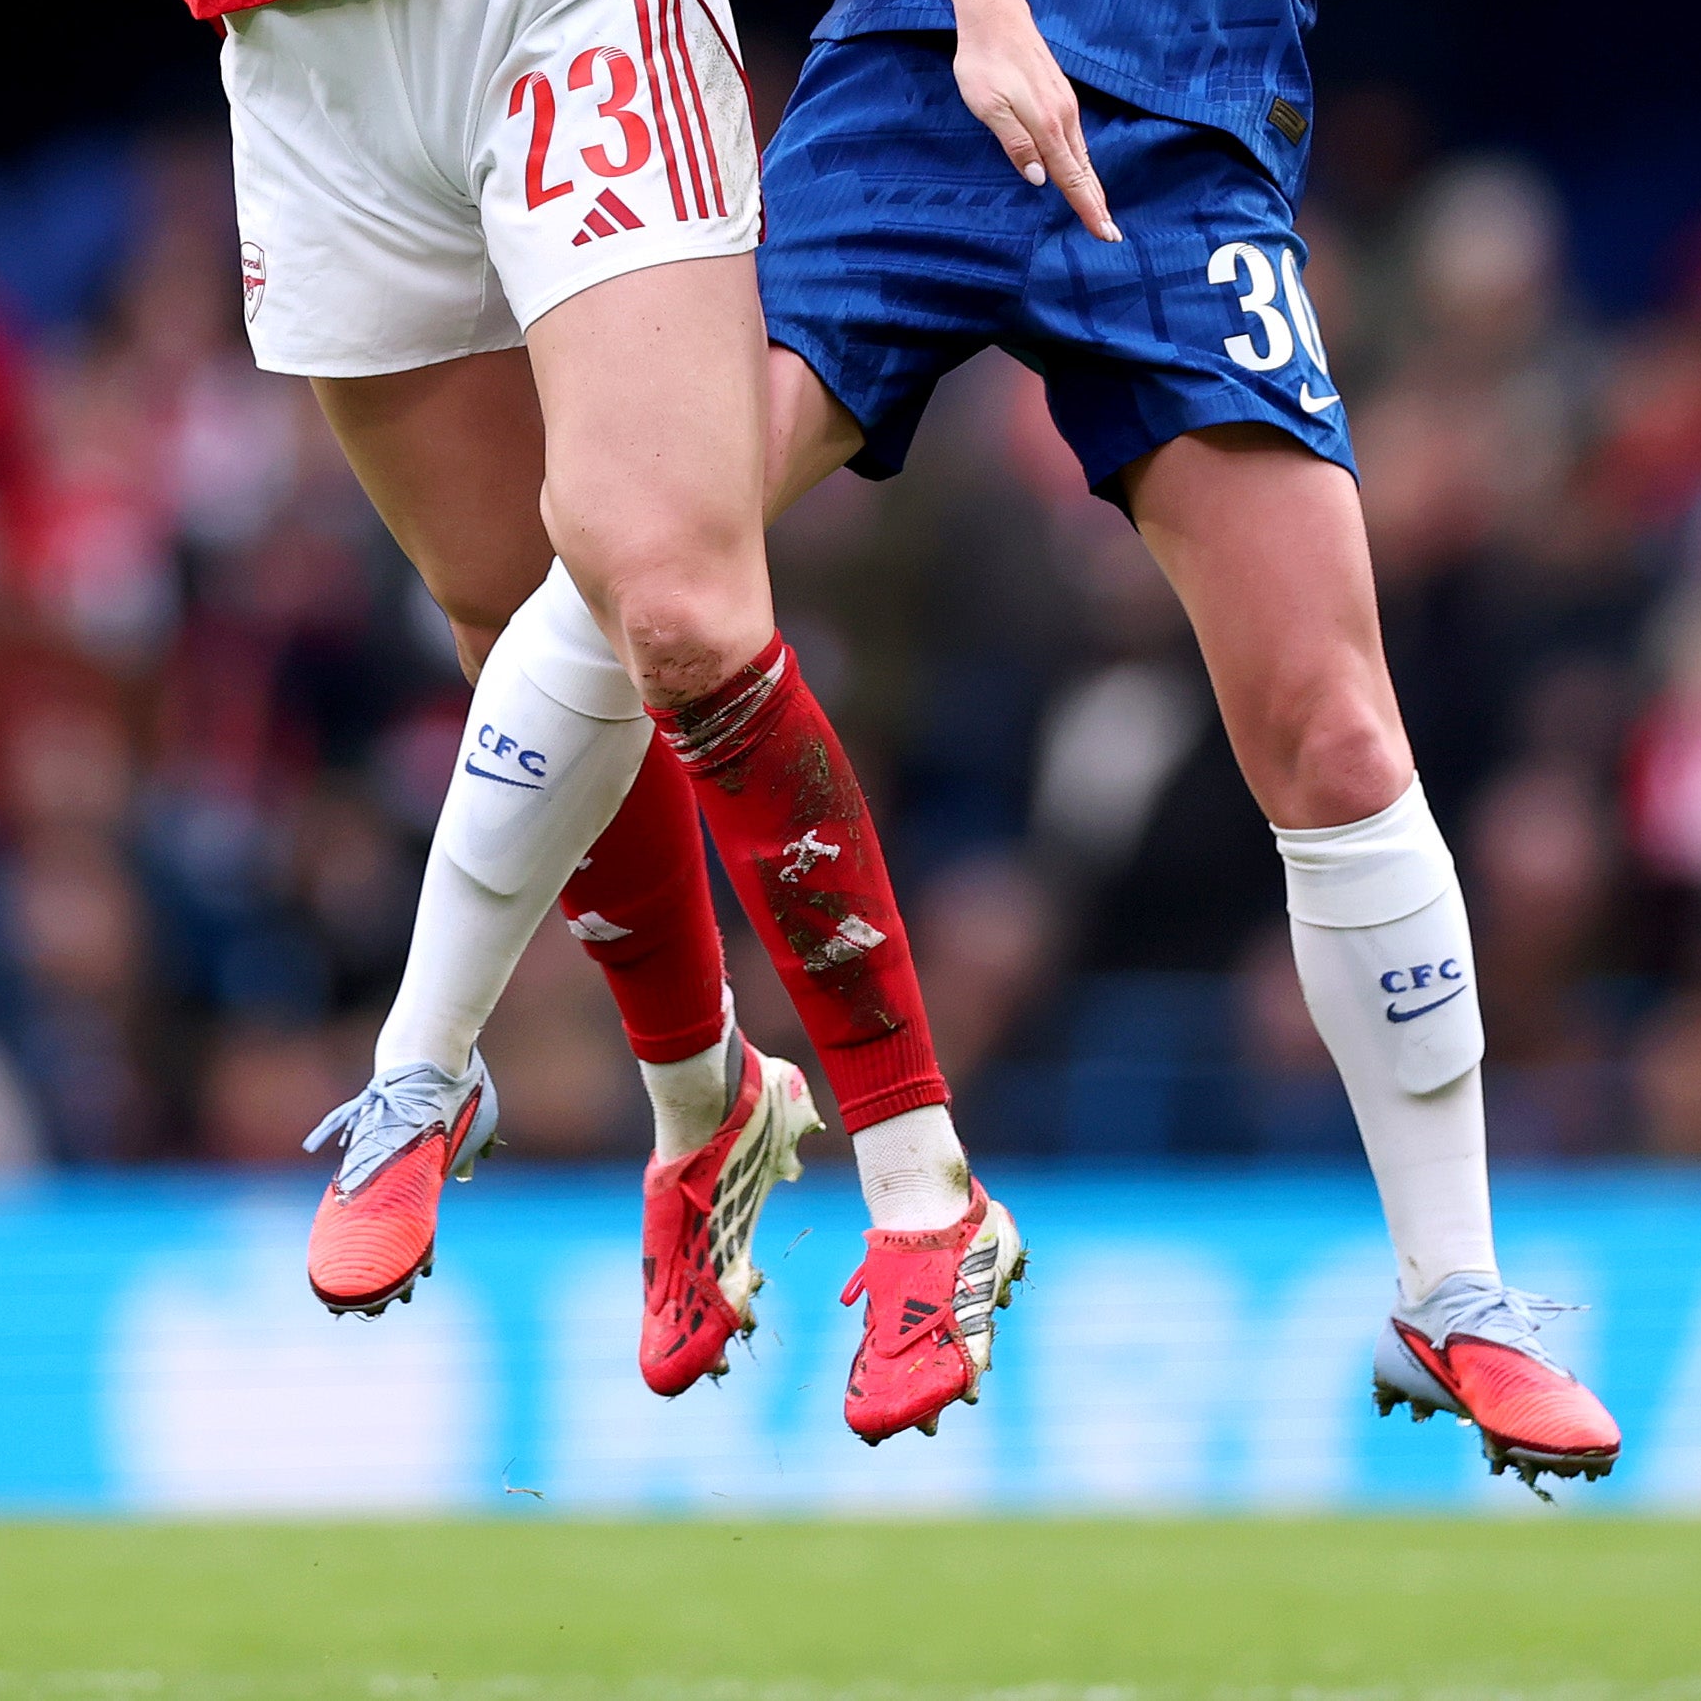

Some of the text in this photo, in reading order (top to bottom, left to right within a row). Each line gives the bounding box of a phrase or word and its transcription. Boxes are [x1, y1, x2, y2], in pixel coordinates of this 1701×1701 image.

[507, 45, 652, 211] 23
[478, 724, 547, 777] CFC
[1380, 958, 1463, 994] CFC
